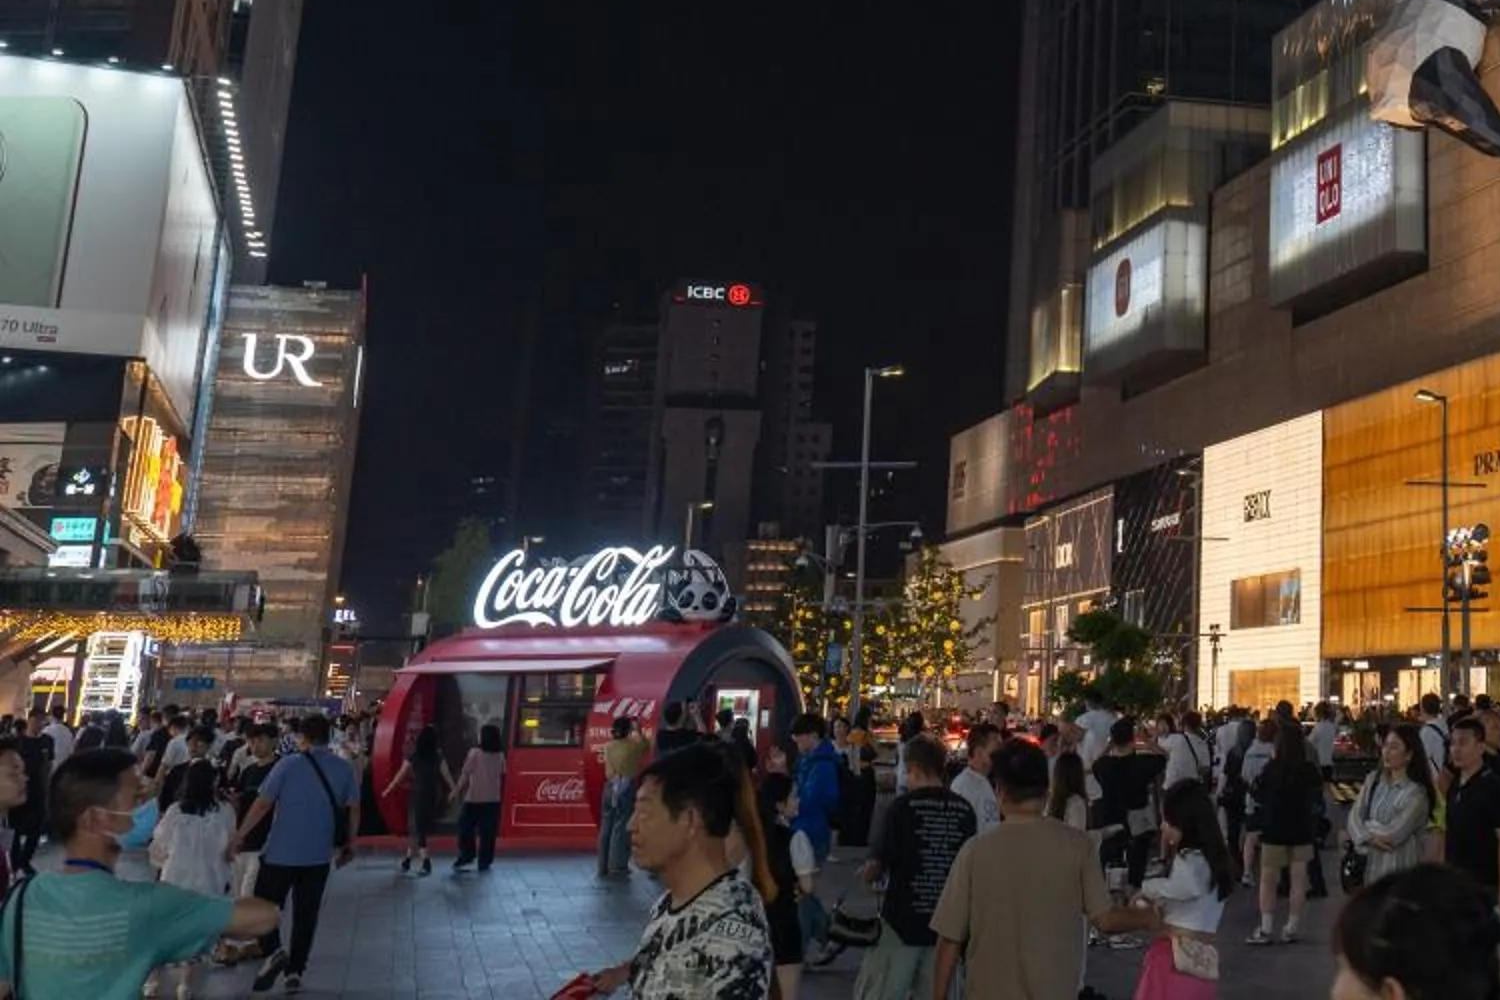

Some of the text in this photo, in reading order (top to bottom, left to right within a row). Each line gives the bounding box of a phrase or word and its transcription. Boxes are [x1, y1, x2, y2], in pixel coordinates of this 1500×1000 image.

[1319, 183, 1339, 216] QLO
[687, 285, 725, 299] ICBC
[23, 320, 58, 335] Ultra
[241, 332, 323, 387] UR
[473, 545, 676, 629] Coca-Cola
